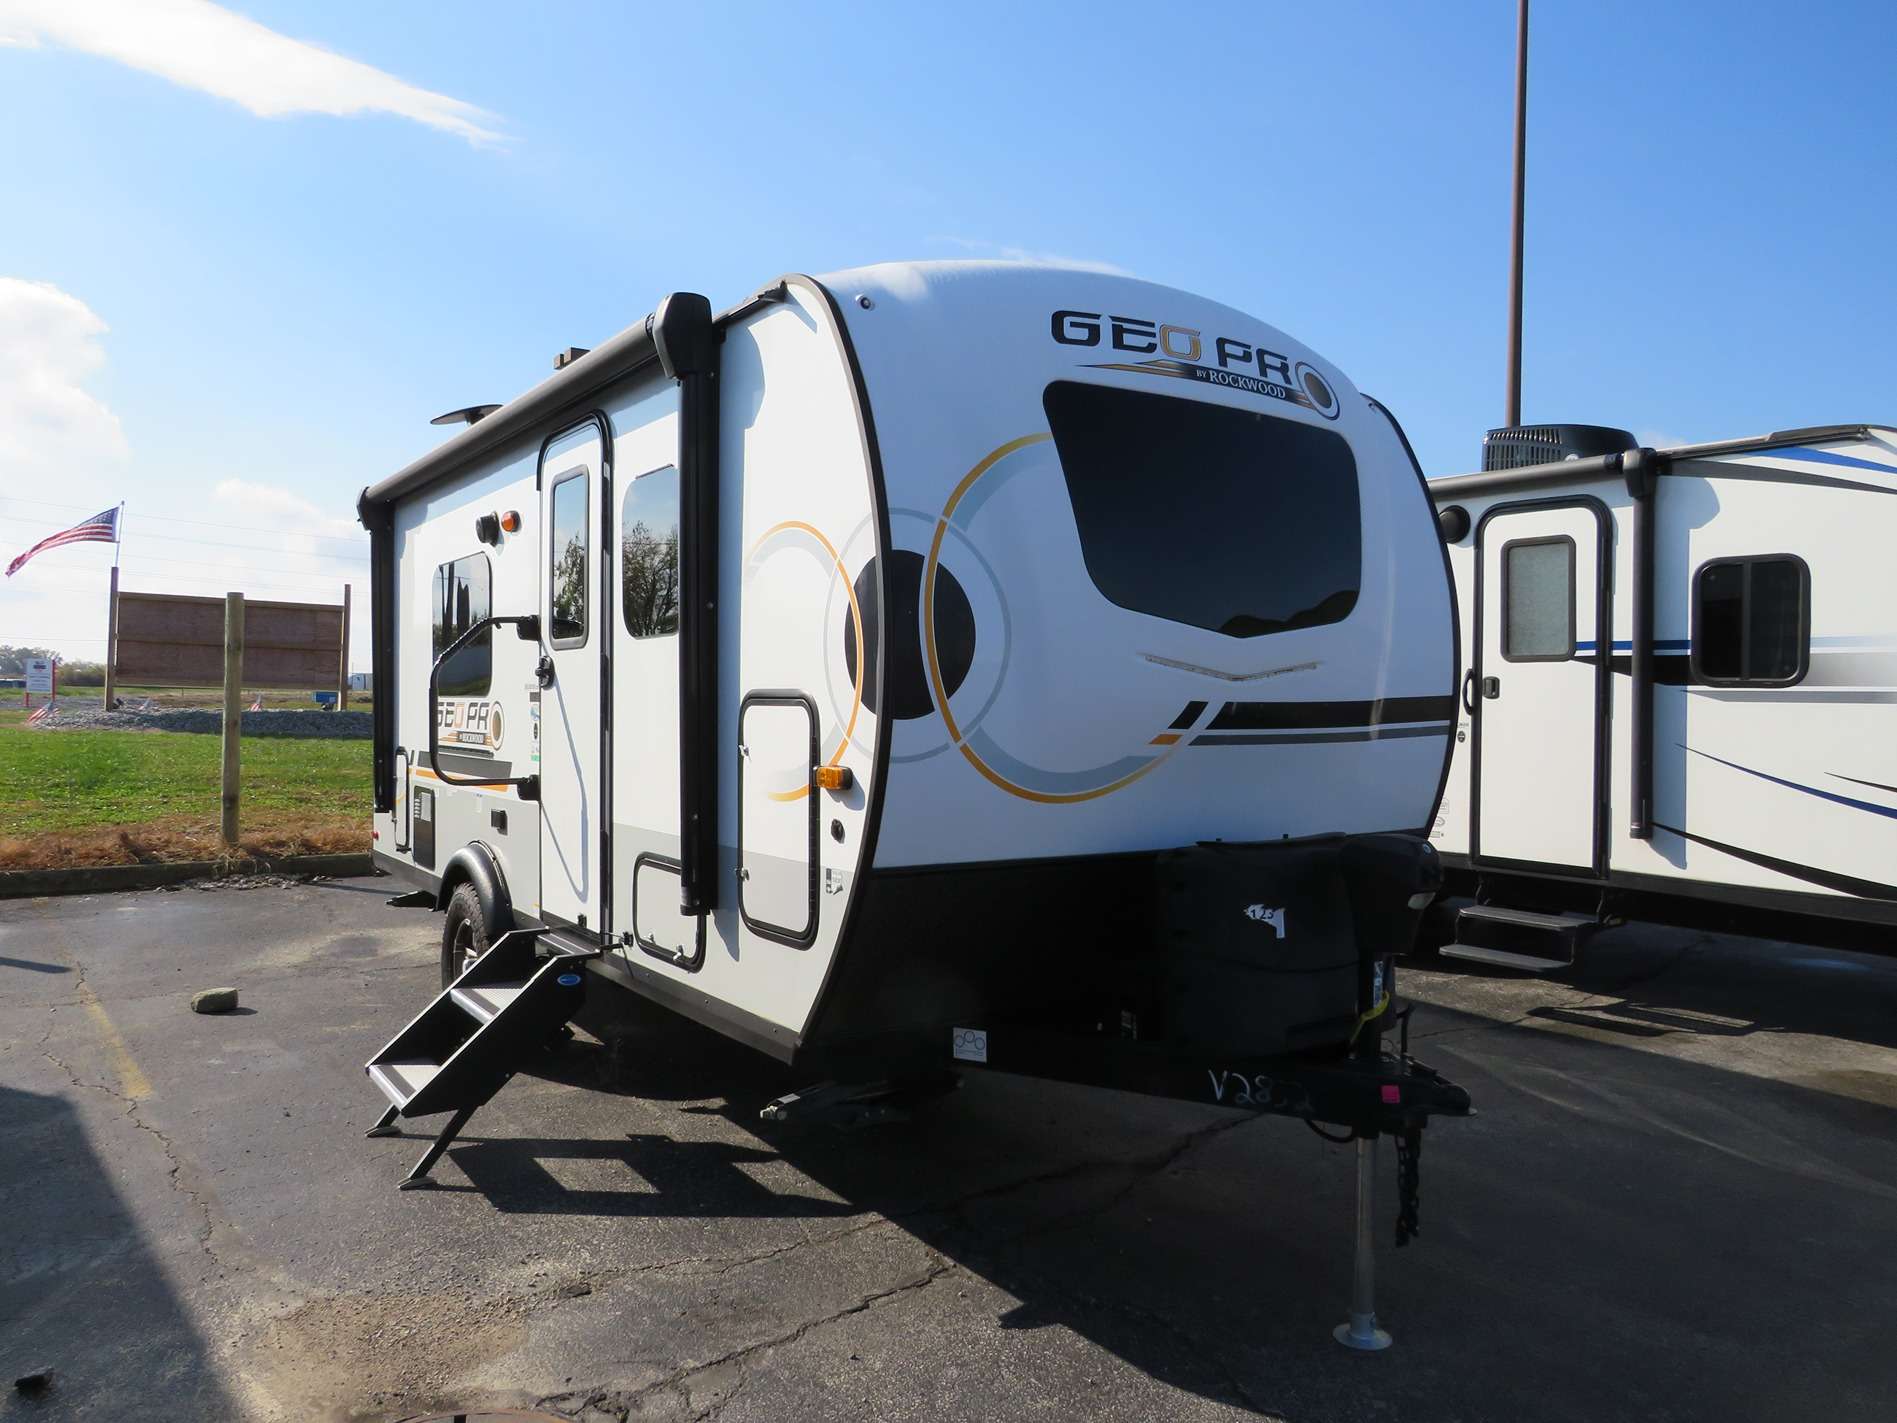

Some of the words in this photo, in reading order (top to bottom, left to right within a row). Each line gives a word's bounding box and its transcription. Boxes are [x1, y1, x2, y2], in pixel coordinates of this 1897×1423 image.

[1051, 310, 1202, 361] GEO
[1196, 369, 1207, 378] BY
[1209, 370, 1286, 399] ROCKWOOD
